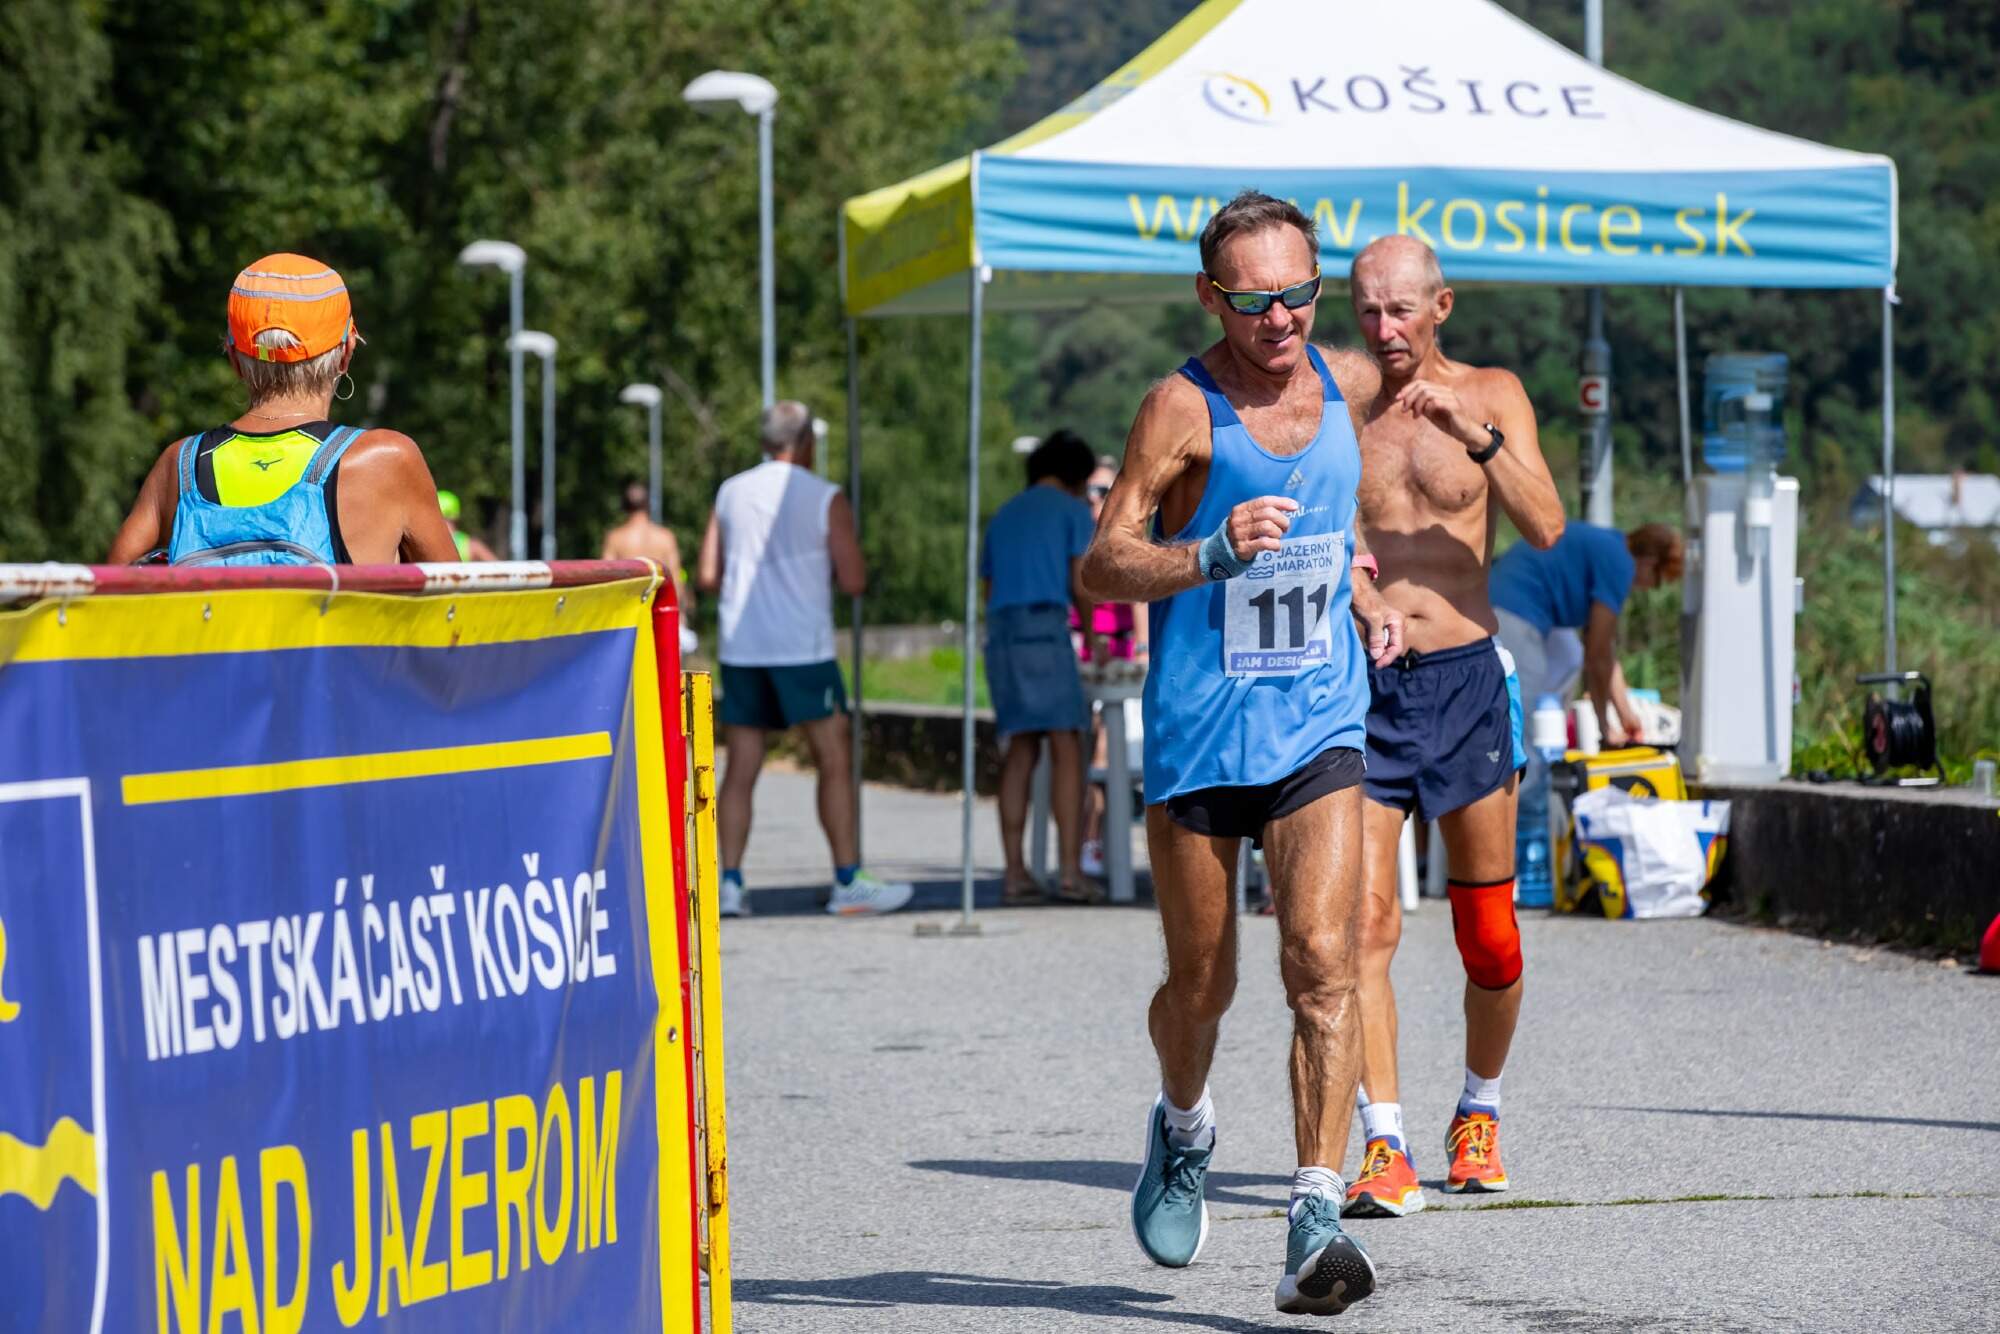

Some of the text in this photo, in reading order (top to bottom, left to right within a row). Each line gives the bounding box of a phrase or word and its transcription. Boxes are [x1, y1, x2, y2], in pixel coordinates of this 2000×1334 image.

[1292, 66, 1606, 120] KOŠICE
[1128, 182, 1757, 258] ww.kosice.sk
[1582, 382, 1601, 409] C
[1276, 538, 1332, 559] JAZERNÝ
[1276, 555, 1333, 572] MARATÓN
[138, 853, 617, 1061] MESTSKÁ ČASŤ KOŠICE
[151, 1069, 622, 1334] NAD JAZEROM
